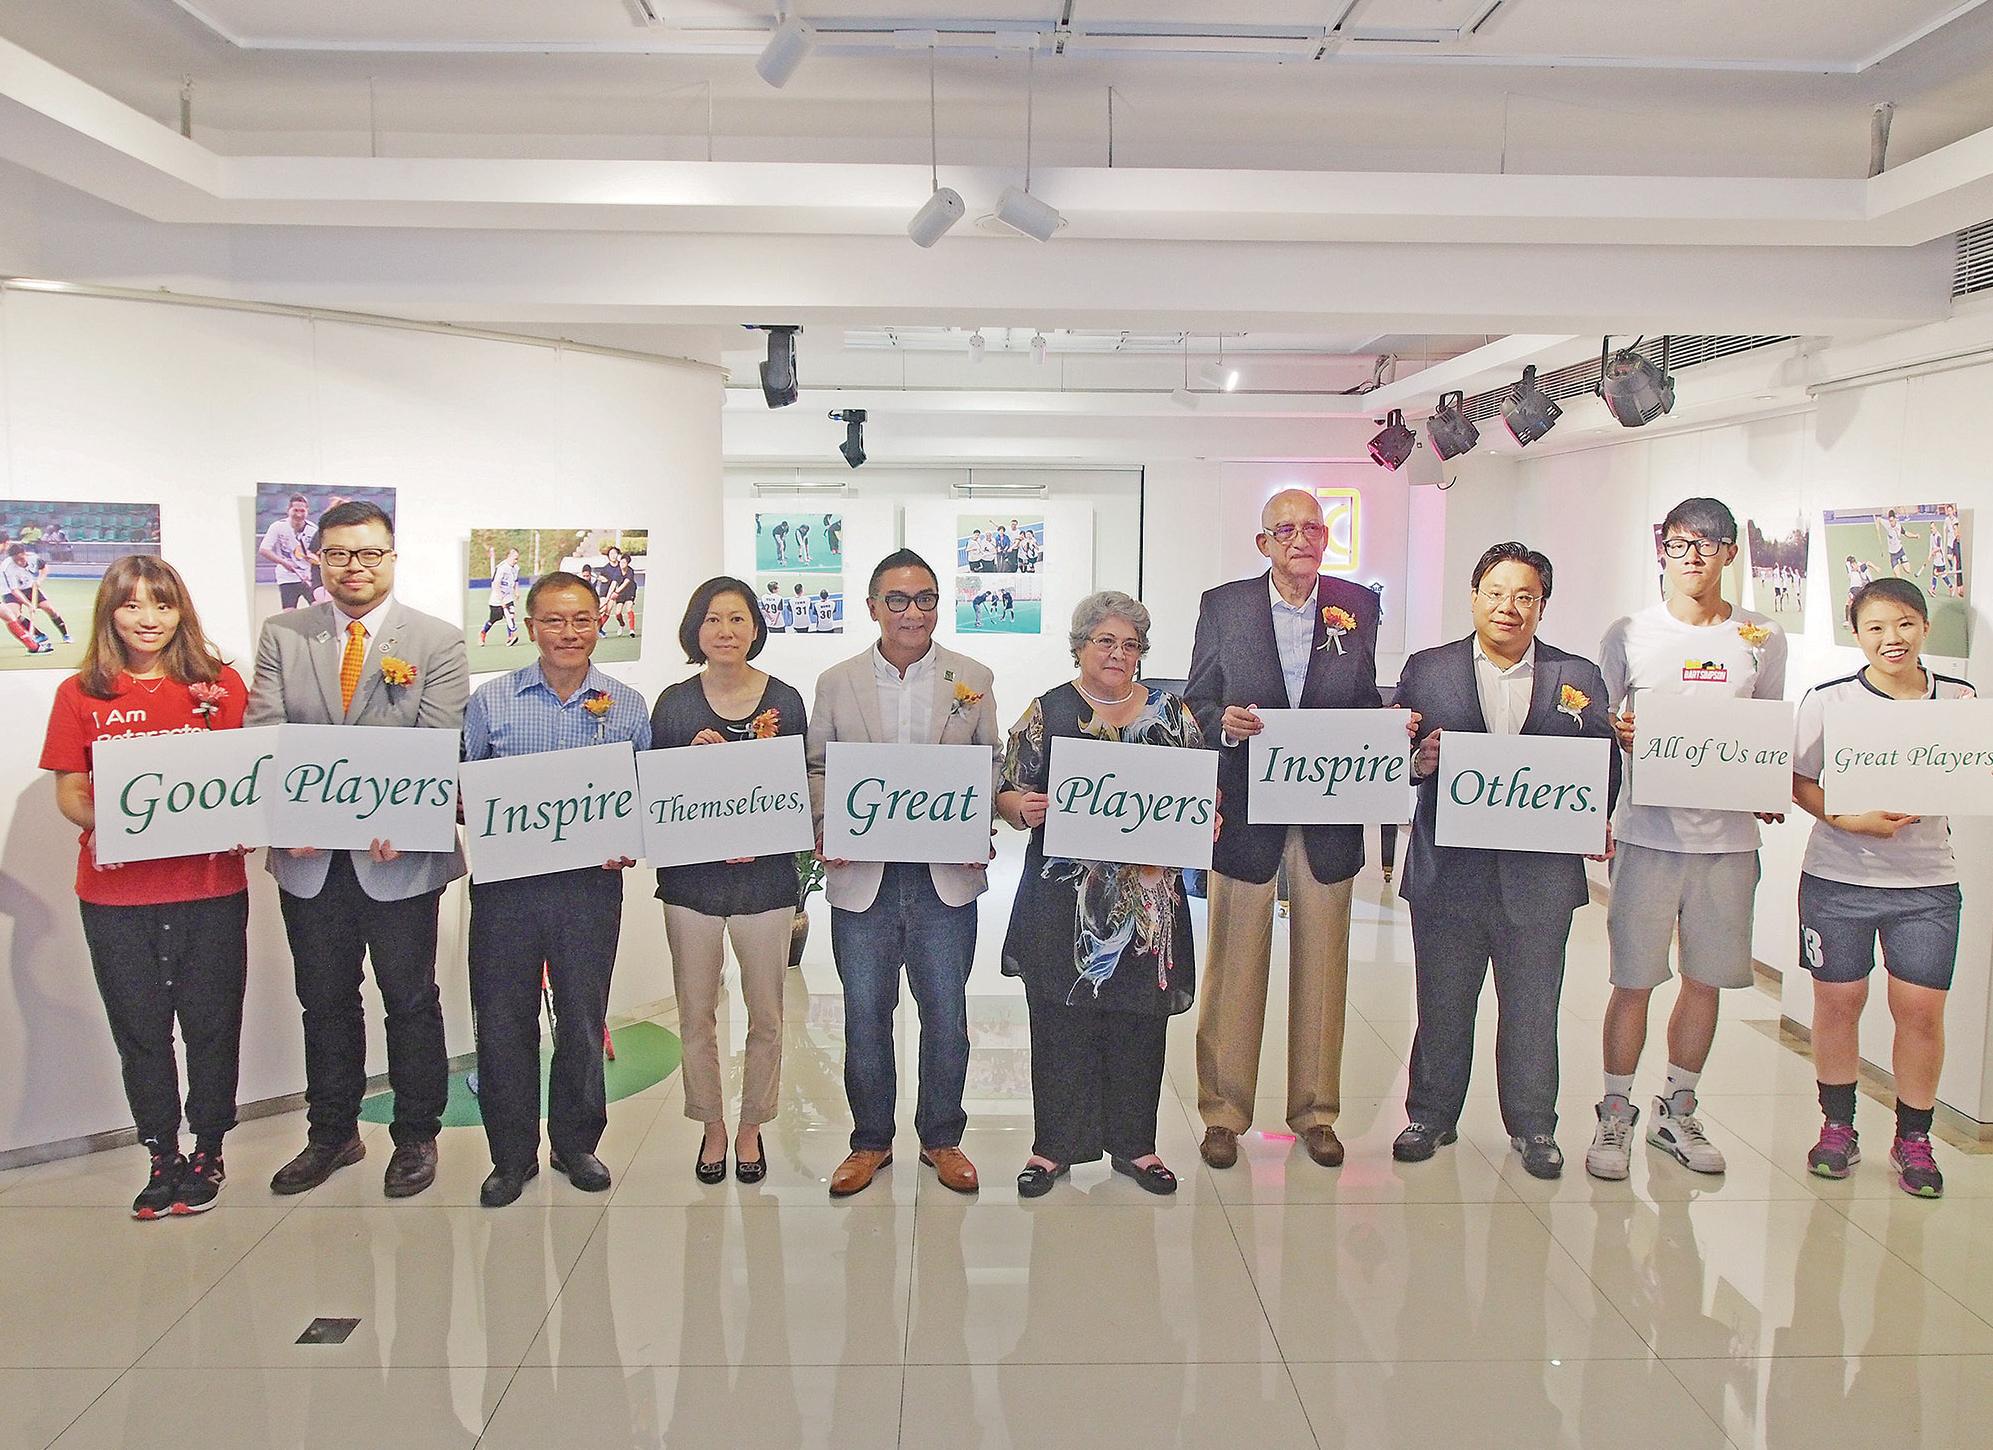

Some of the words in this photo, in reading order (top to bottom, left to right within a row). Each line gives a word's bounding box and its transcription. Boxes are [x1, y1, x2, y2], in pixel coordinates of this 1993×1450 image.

[764, 603, 777, 614] 29
[795, 606, 807, 615] 31
[820, 610, 831, 620] 30
[92, 711, 100, 729] I
[105, 709, 147, 726] Am
[1259, 744, 1404, 796] Inspire
[1640, 736, 1684, 760] All
[1685, 738, 1713, 767] of
[1716, 740, 1749, 763] Us
[1755, 749, 1788, 765] are
[1835, 747, 1899, 774] Great
[1907, 743, 1993, 773] Players
[120, 754, 273, 834] Good
[283, 758, 453, 820] Players
[649, 785, 804, 824] Themselves,
[847, 777, 978, 836] Great
[1056, 773, 1212, 833] Players
[1450, 766, 1597, 812] Others.
[480, 782, 633, 842] Inspire
